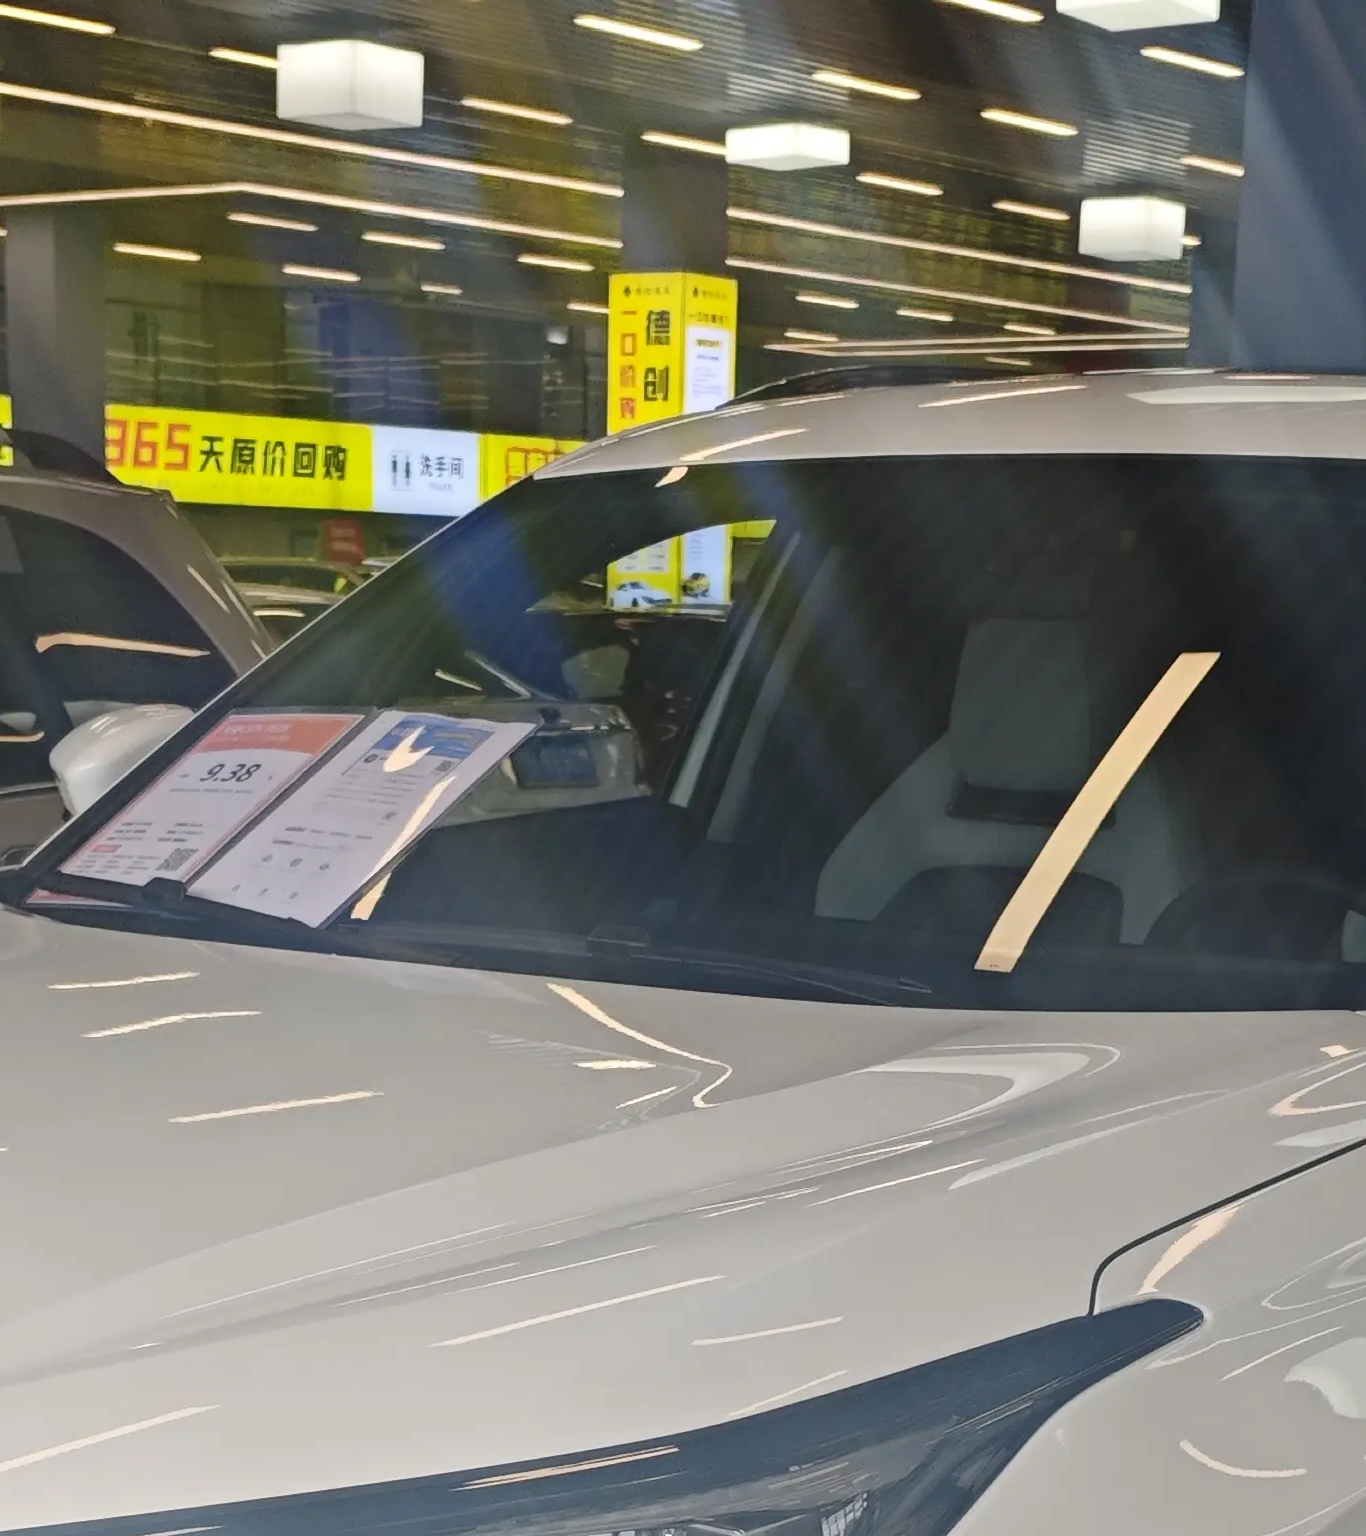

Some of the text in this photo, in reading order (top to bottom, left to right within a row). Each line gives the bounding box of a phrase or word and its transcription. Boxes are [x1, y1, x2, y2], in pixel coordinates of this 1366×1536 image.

[644, 310, 671, 402] 德创
[420, 453, 465, 479] 洗手间
[200, 763, 262, 782] 9.38
